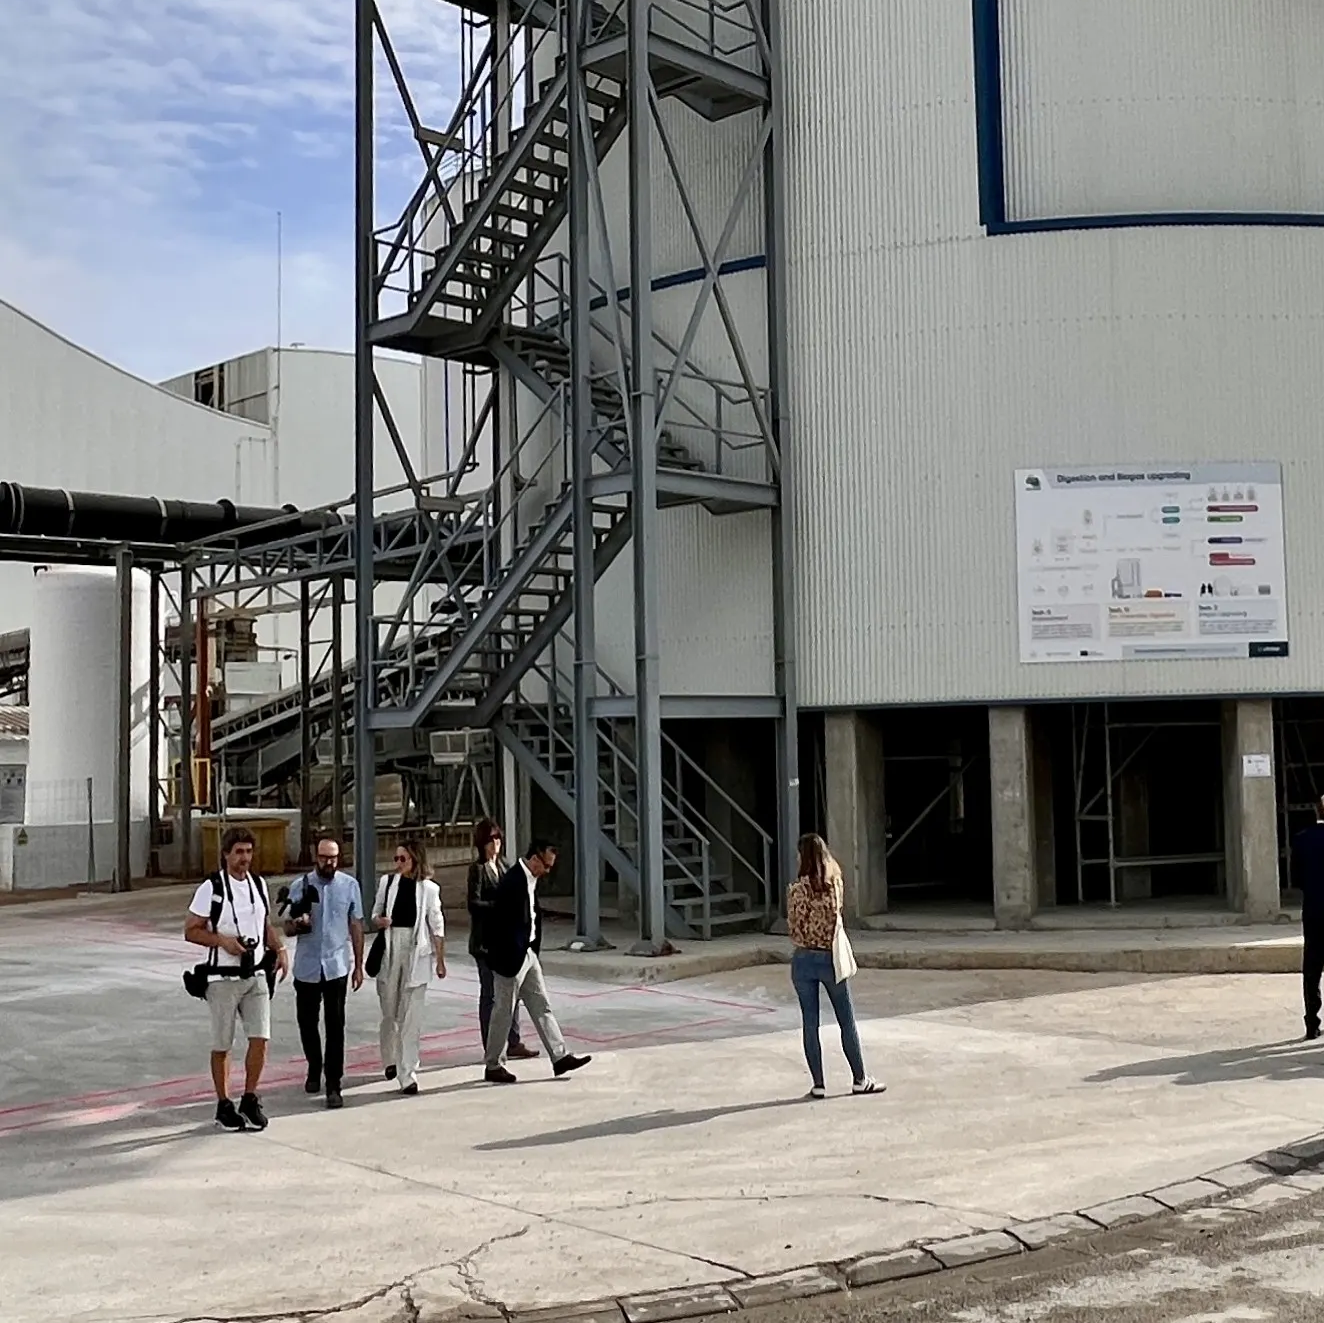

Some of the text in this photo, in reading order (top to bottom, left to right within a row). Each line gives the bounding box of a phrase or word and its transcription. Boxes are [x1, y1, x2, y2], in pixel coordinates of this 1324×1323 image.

[1057, 474, 1097, 484] Digestion
[1098, 473, 1115, 481] and
[1147, 471, 1191, 481] upgrading
